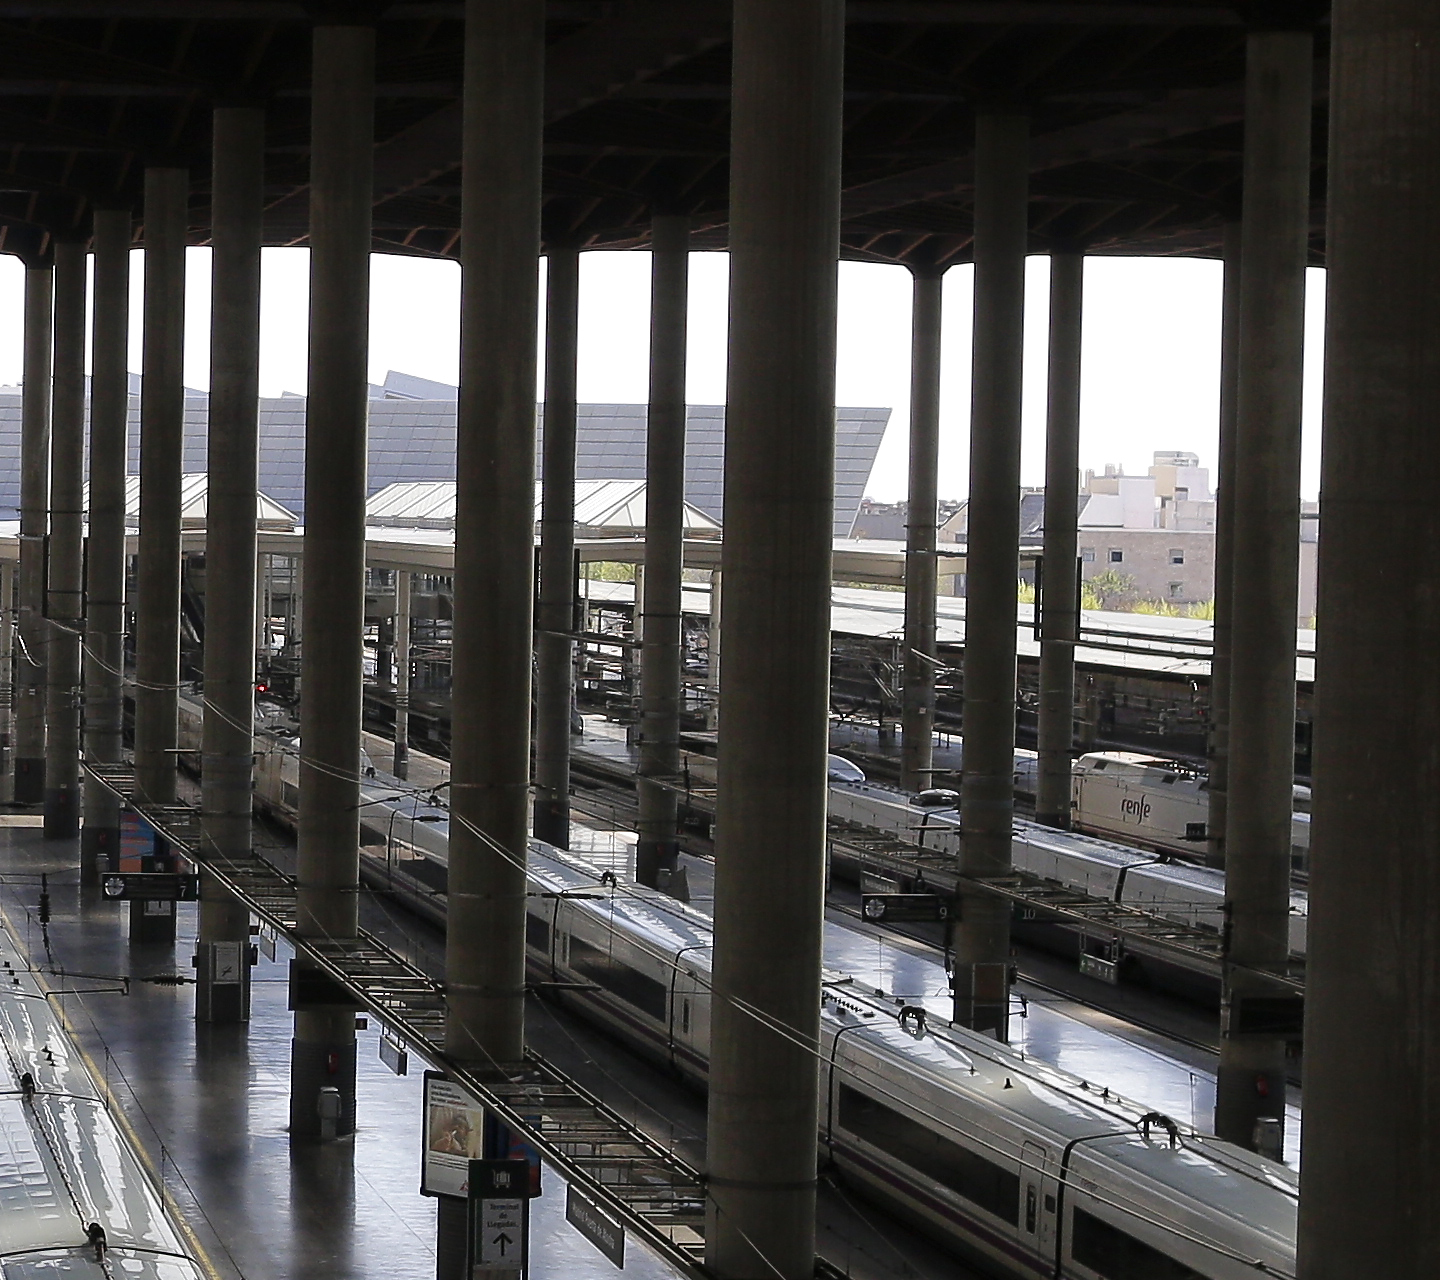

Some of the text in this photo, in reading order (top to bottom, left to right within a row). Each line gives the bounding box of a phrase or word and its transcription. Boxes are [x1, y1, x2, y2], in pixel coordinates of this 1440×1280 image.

[1121, 793, 1151, 825] renfe
[179, 885, 187, 898] 7
[939, 906, 948, 920] 9
[1022, 908, 1036, 920] 10
